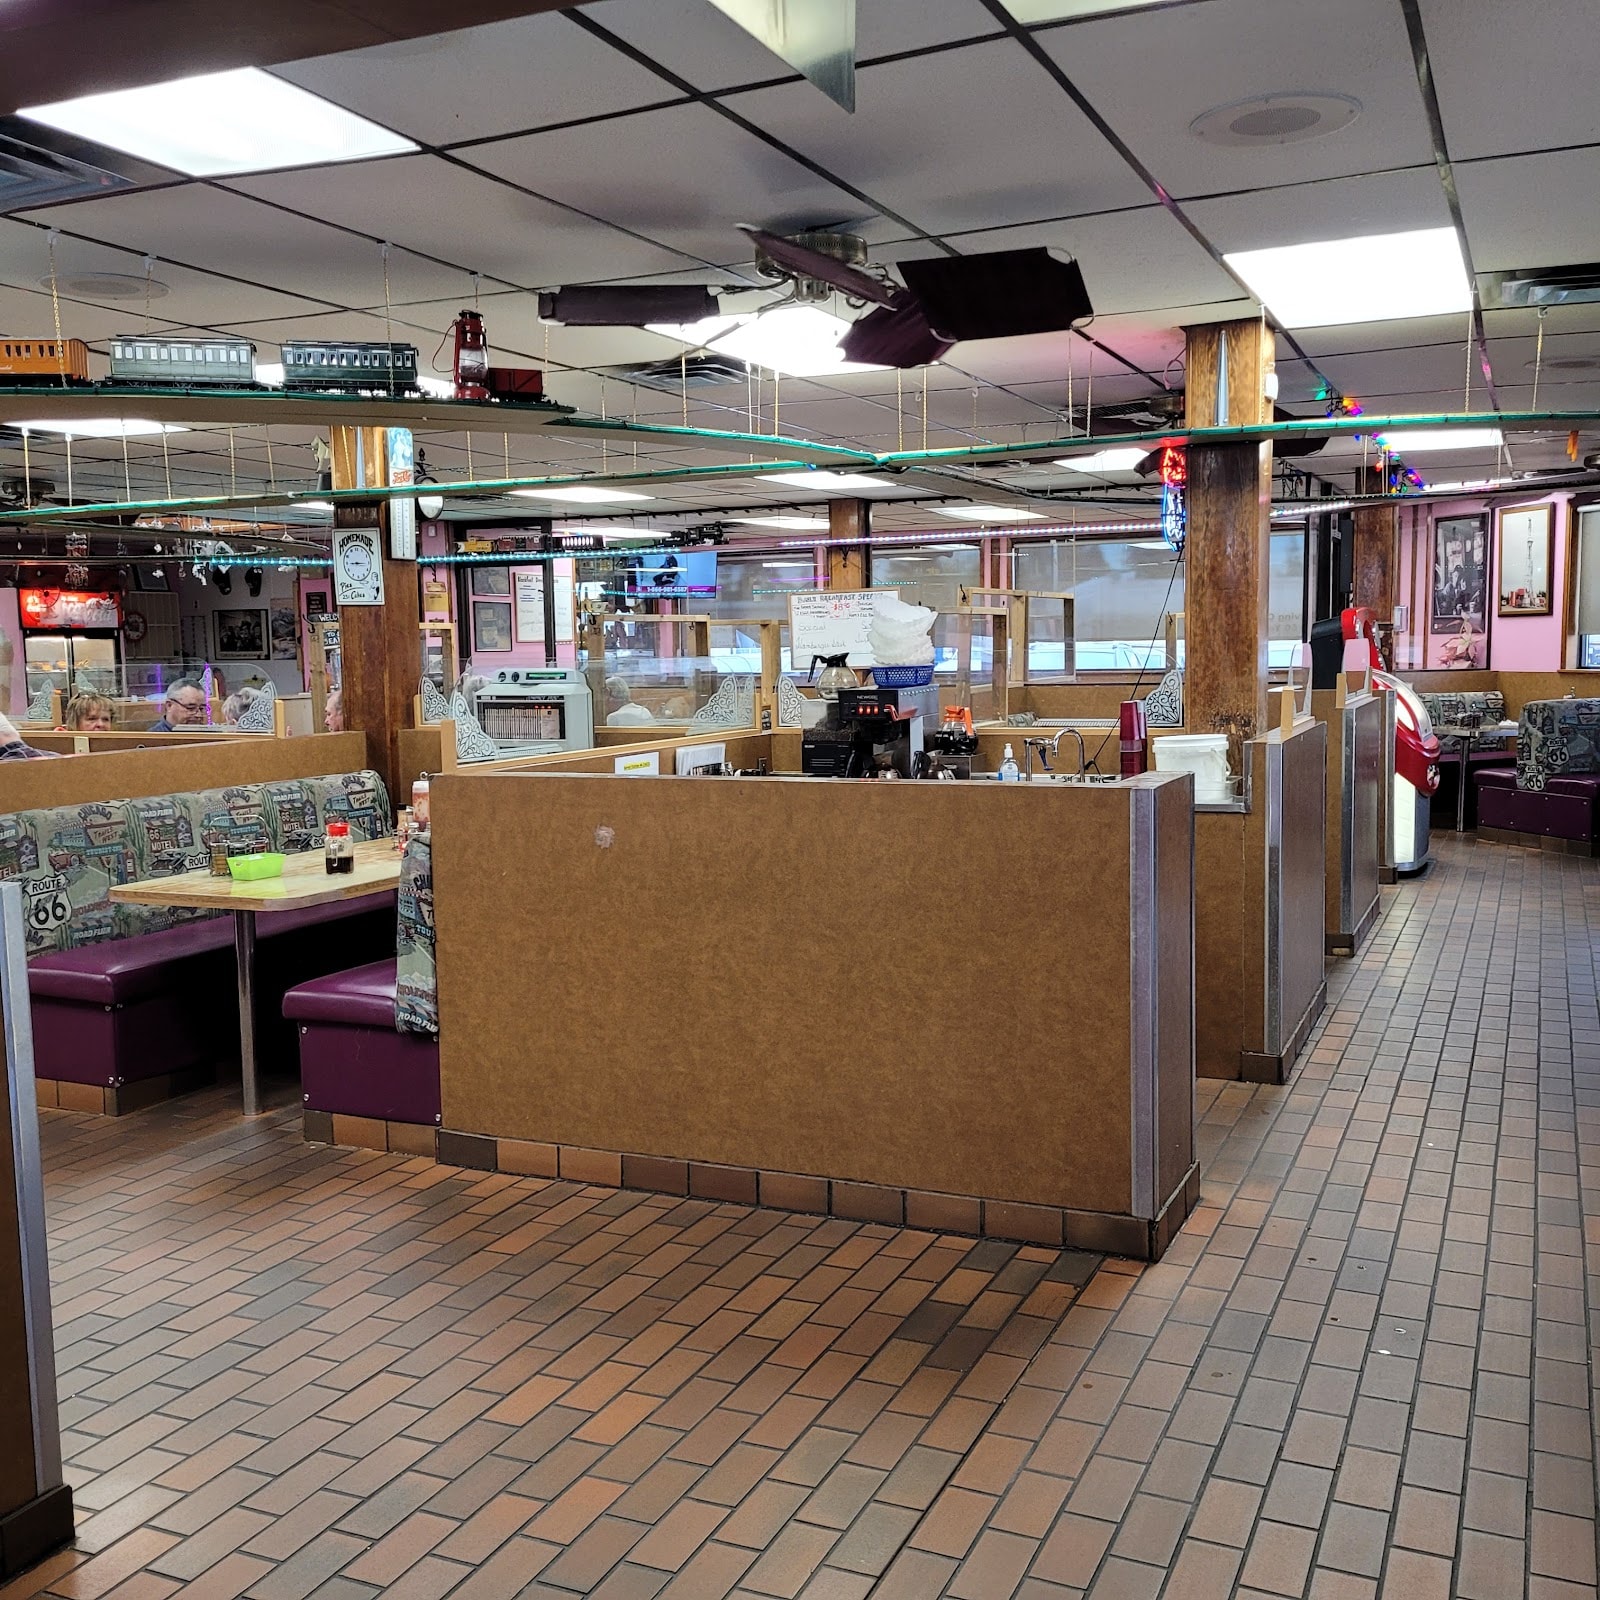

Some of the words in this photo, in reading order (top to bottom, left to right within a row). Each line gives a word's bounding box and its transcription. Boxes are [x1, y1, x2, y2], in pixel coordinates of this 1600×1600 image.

[338, 533, 374, 556] HOMEMADE
[340, 581, 352, 593] Pies
[1550, 747, 1568, 762] 66
[1528, 774, 1542, 789] 66
[77, 804, 113, 821] CHICAGO
[149, 829, 161, 841] 66
[151, 840, 173, 851] MOTEL
[188, 855, 209, 868] ROUT
[0, 867, 15, 877] TEL
[32, 879, 62, 892] ROUTE
[35, 894, 66, 924] 66
[397, 1012, 422, 1026] ROAD
